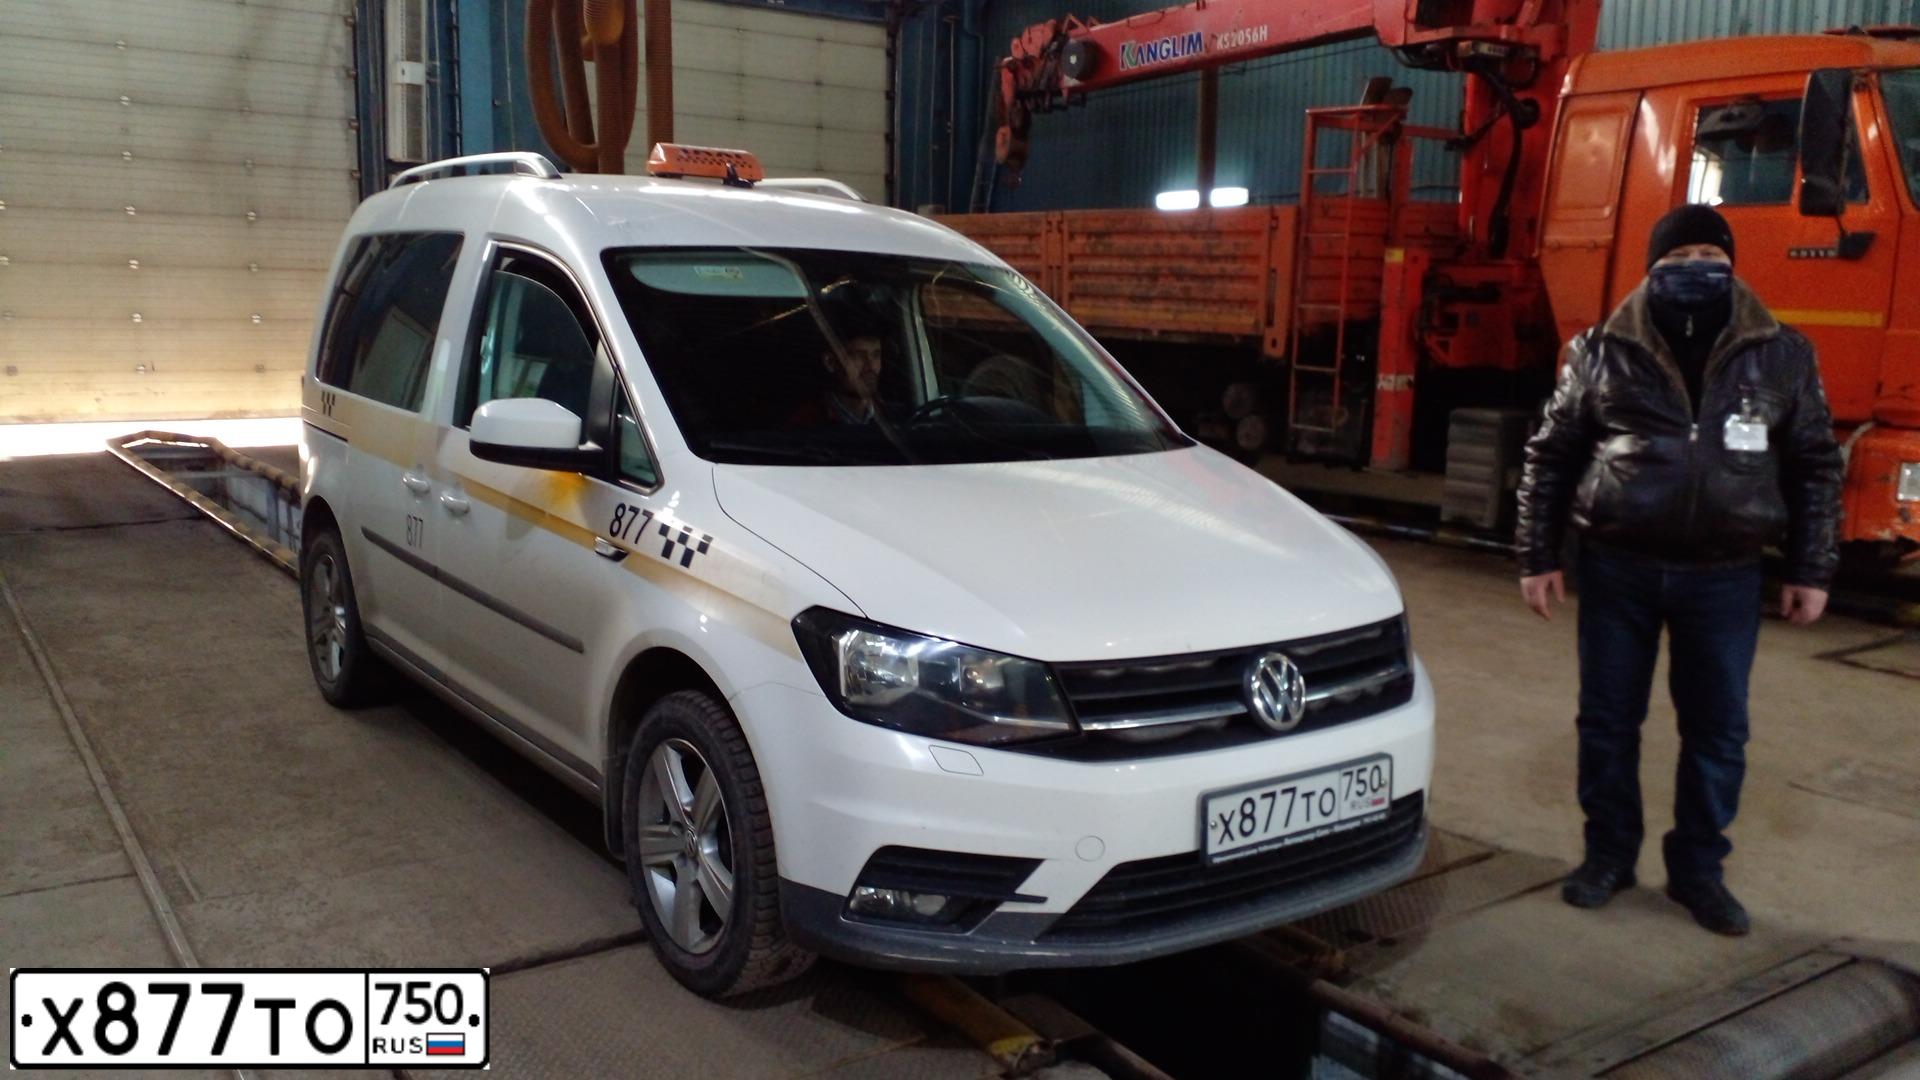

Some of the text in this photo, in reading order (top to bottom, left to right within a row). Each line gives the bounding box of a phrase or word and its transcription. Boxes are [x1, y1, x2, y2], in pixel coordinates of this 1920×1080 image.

[1119, 25, 1268, 70] KANGLIM KS2056H
[406, 514, 424, 548] 877
[609, 503, 654, 544] 877
[1342, 765, 1382, 801] 750
